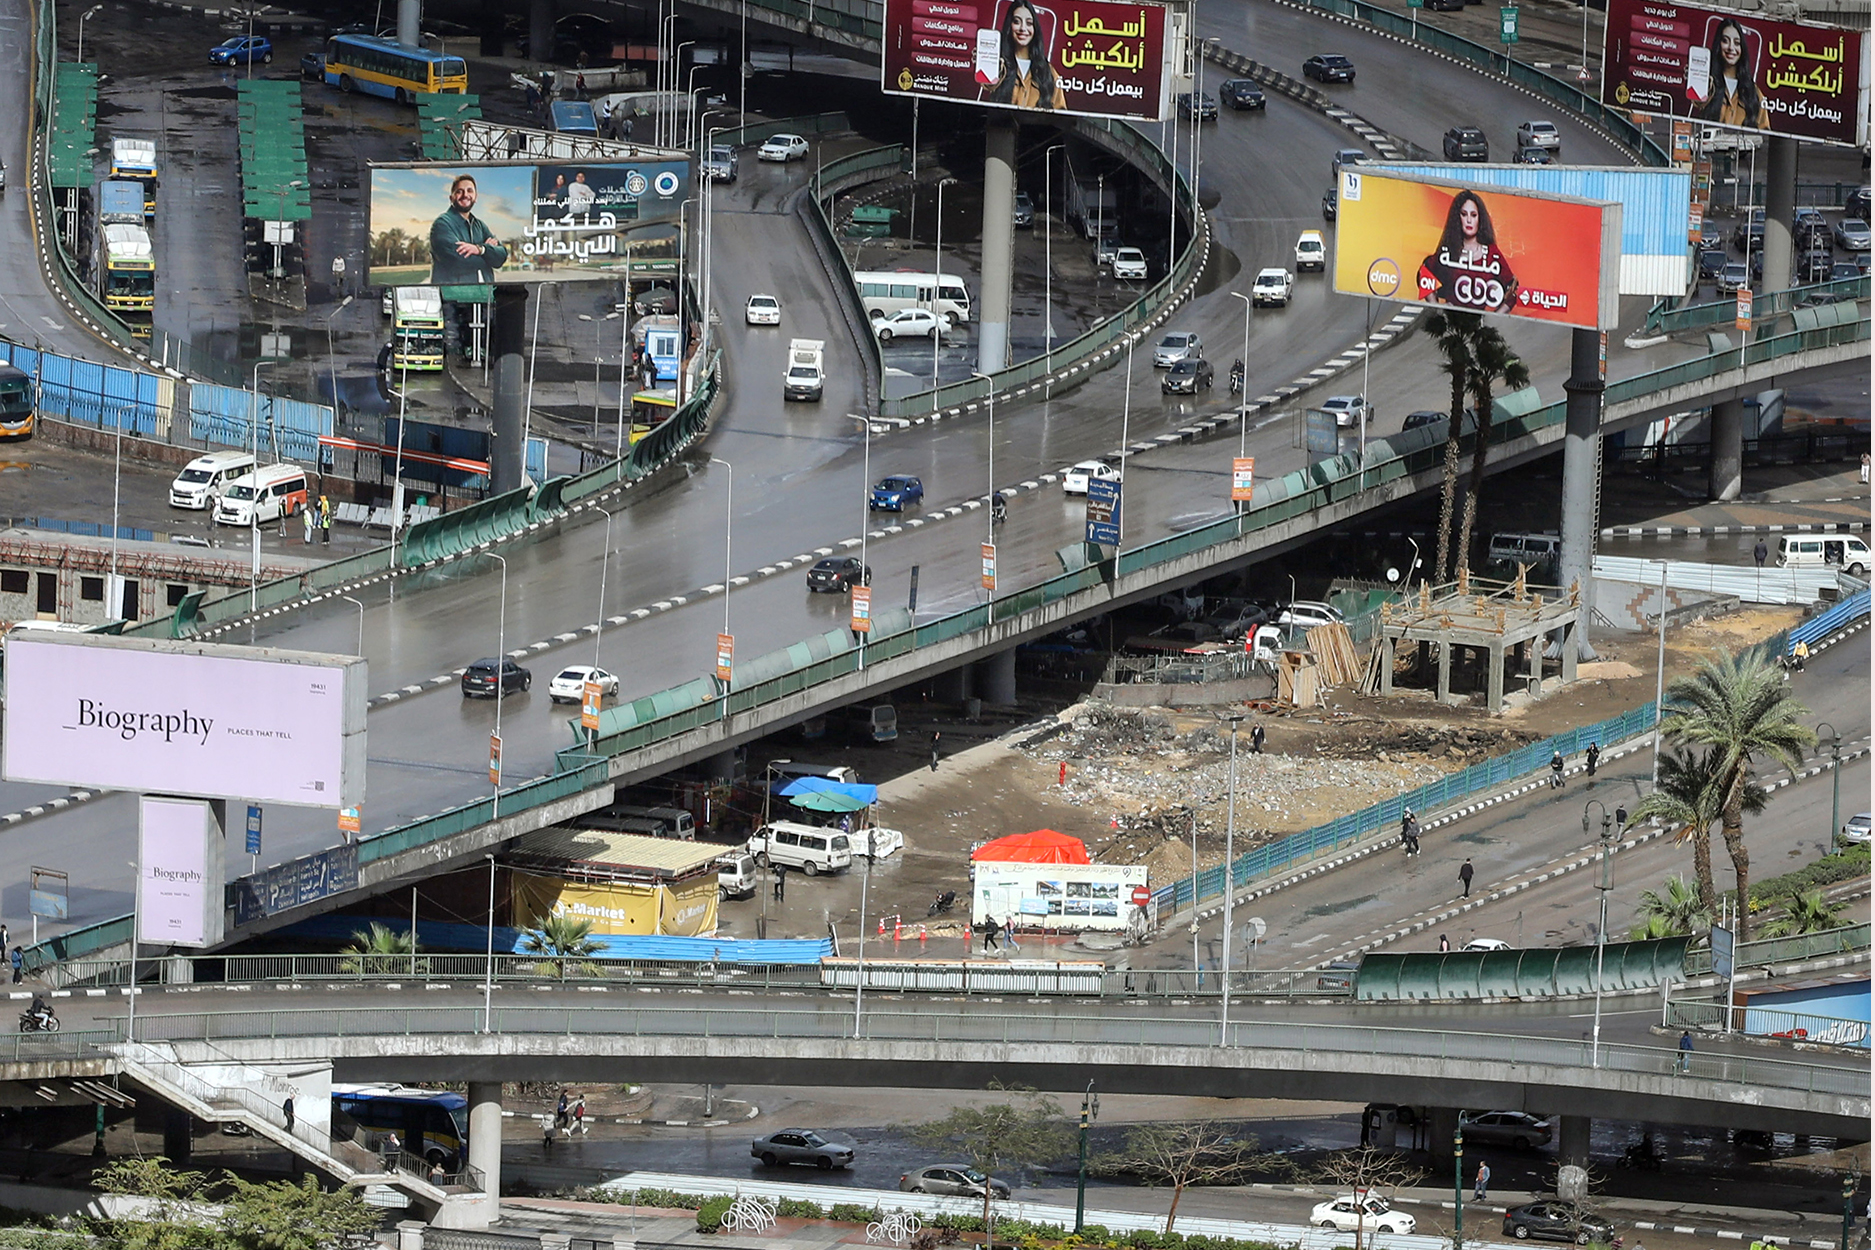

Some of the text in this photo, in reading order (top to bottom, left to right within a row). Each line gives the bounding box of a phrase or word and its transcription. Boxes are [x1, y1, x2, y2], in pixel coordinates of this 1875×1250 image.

[1063, 9, 1146, 38] أسهل
[1061, 39, 1145, 74] أبلكيشن
[1768, 33, 1844, 64] أسهل
[913, 81, 933, 92] BANQUE
[1055, 75, 1144, 99] بيعمل كل حاجة
[1766, 62, 1843, 98] أبلكيشن
[1761, 97, 1842, 123] بيعمل كل حاجة
[523, 211, 617, 237] هنكمل
[1370, 268, 1398, 285] dmc
[1420, 277, 1436, 290] ON
[1531, 291, 1567, 308] الحياة
[227, 727, 254, 737] PLACES
[256, 729, 274, 738] THAT
[276, 731, 292, 739] TELL
[573, 902, 625, 920] Market
